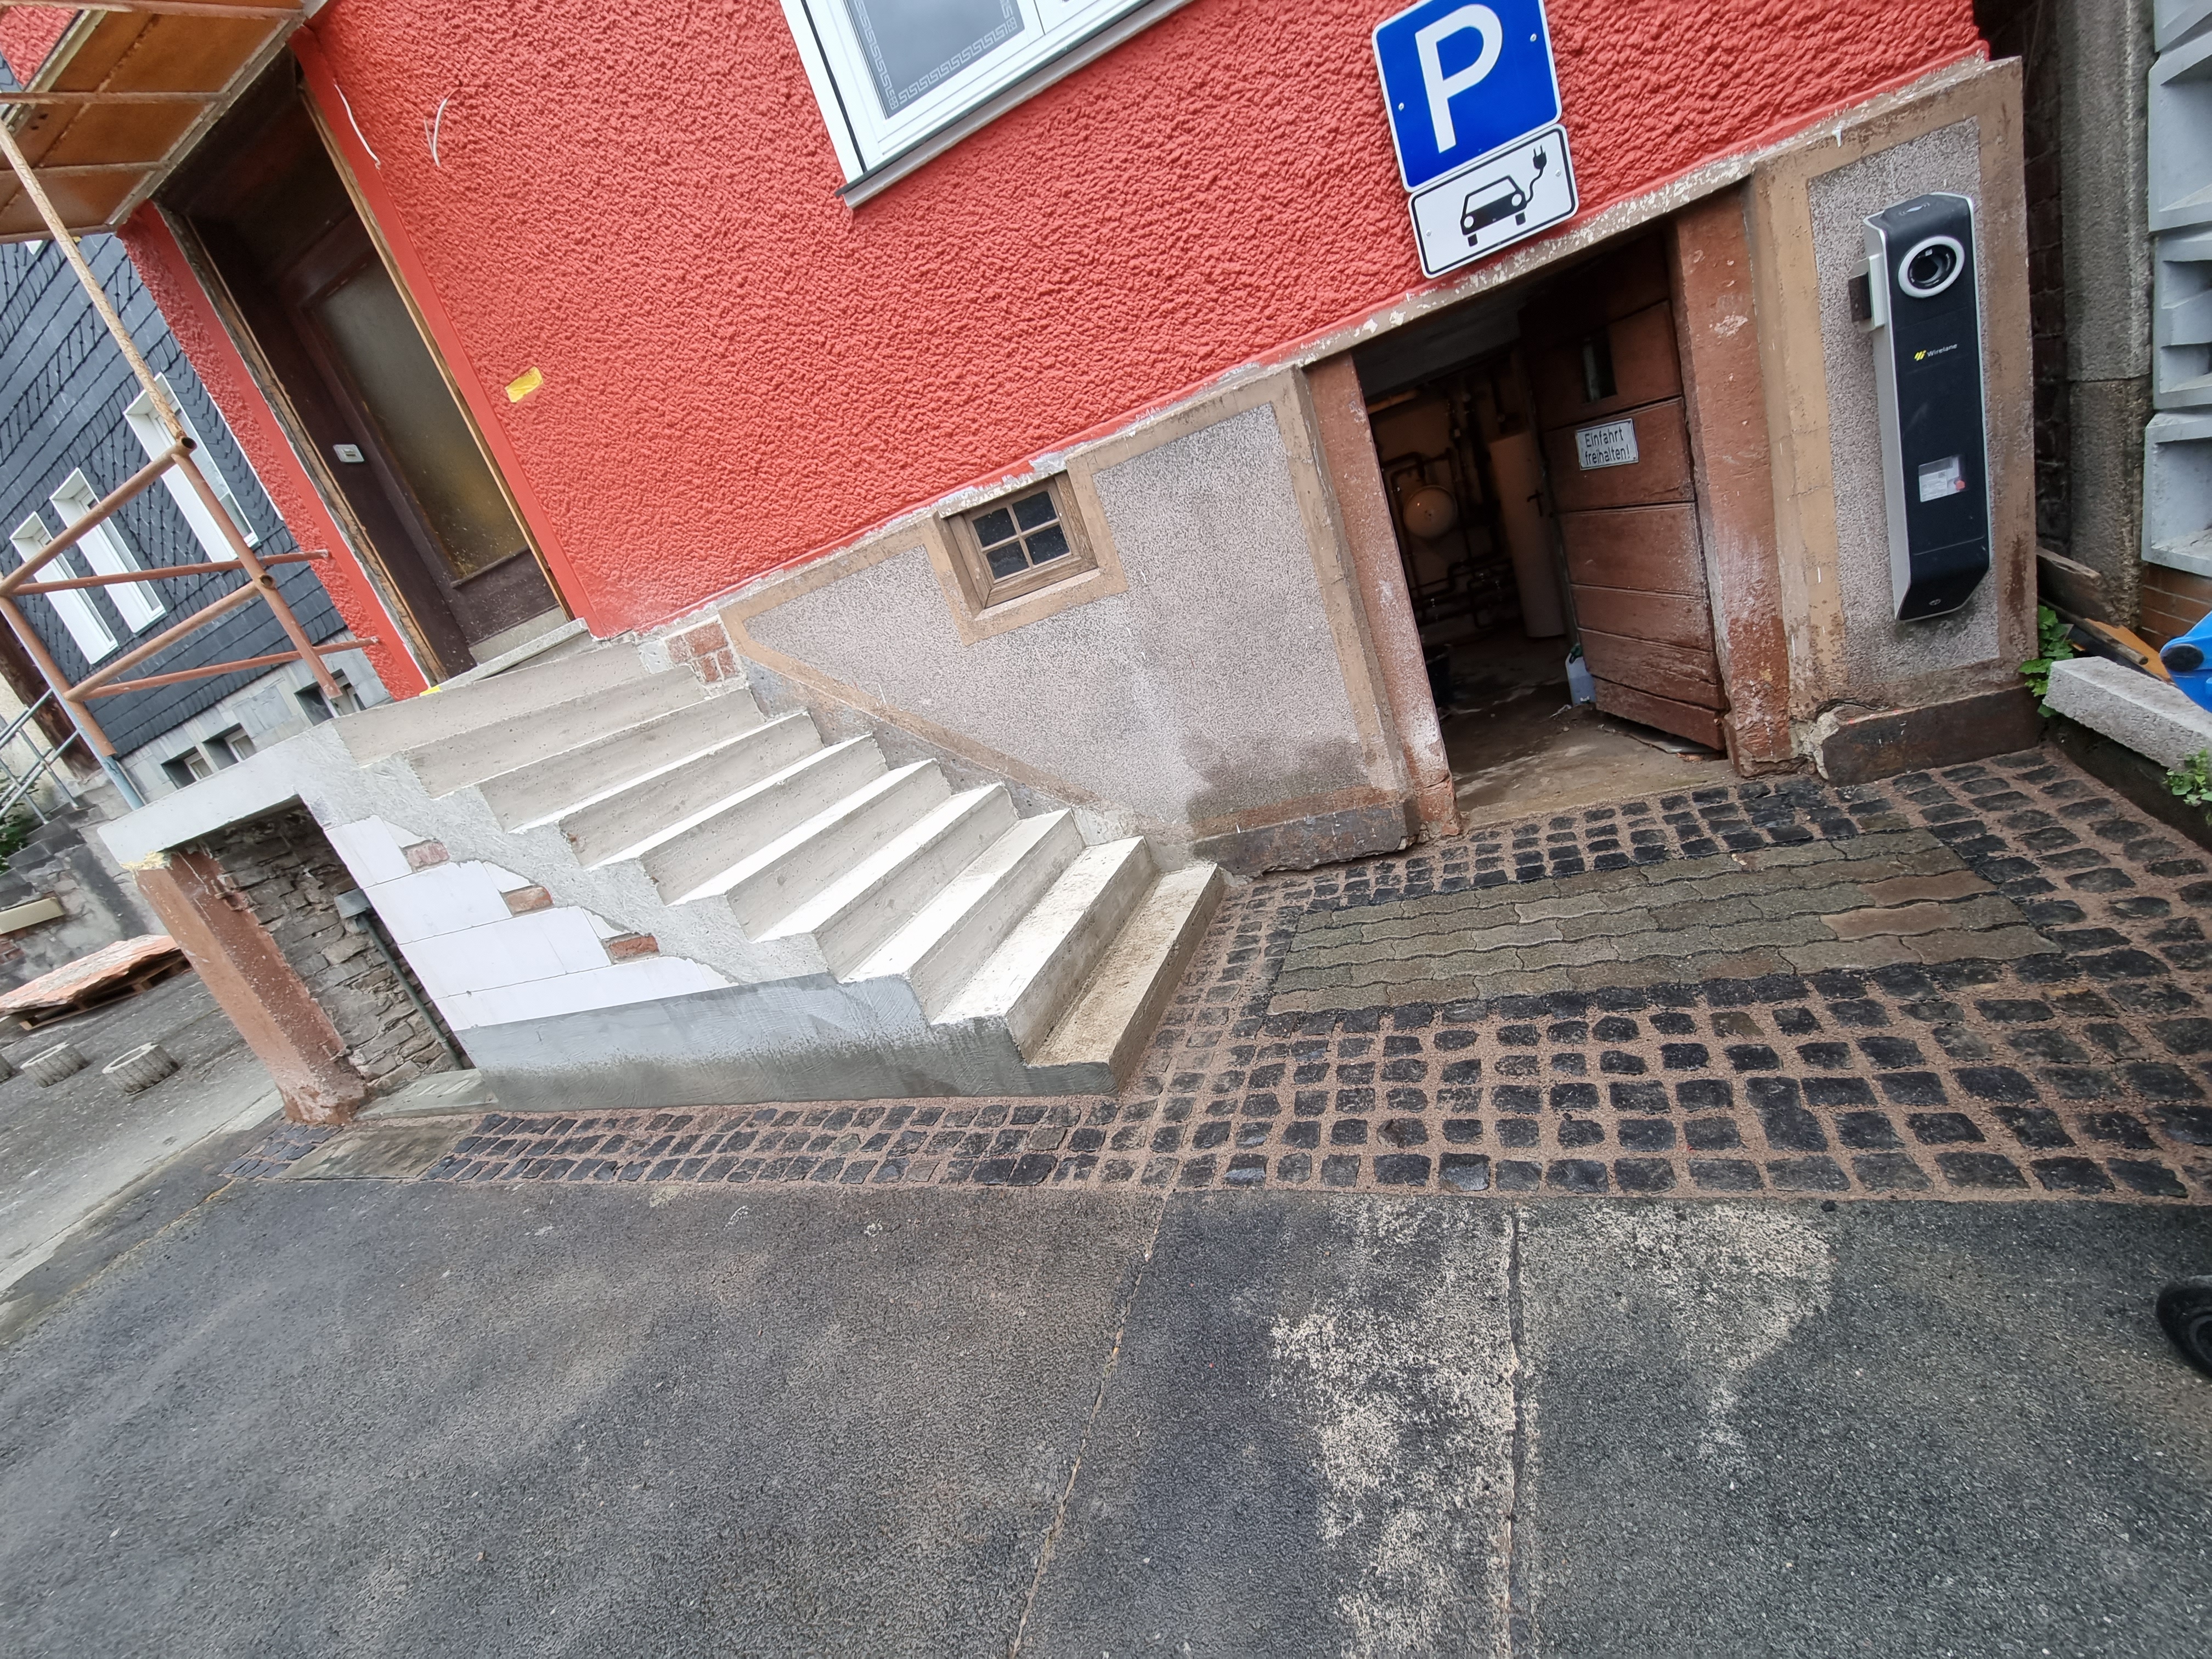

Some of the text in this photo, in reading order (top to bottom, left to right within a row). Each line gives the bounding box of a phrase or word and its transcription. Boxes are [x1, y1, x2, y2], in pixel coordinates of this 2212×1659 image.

[1415, 3, 1503, 154] P
[1927, 343, 1957, 357] Wirelane
[1584, 426, 1624, 448] Einfahrt
[1584, 444, 1630, 465] freihalten!
